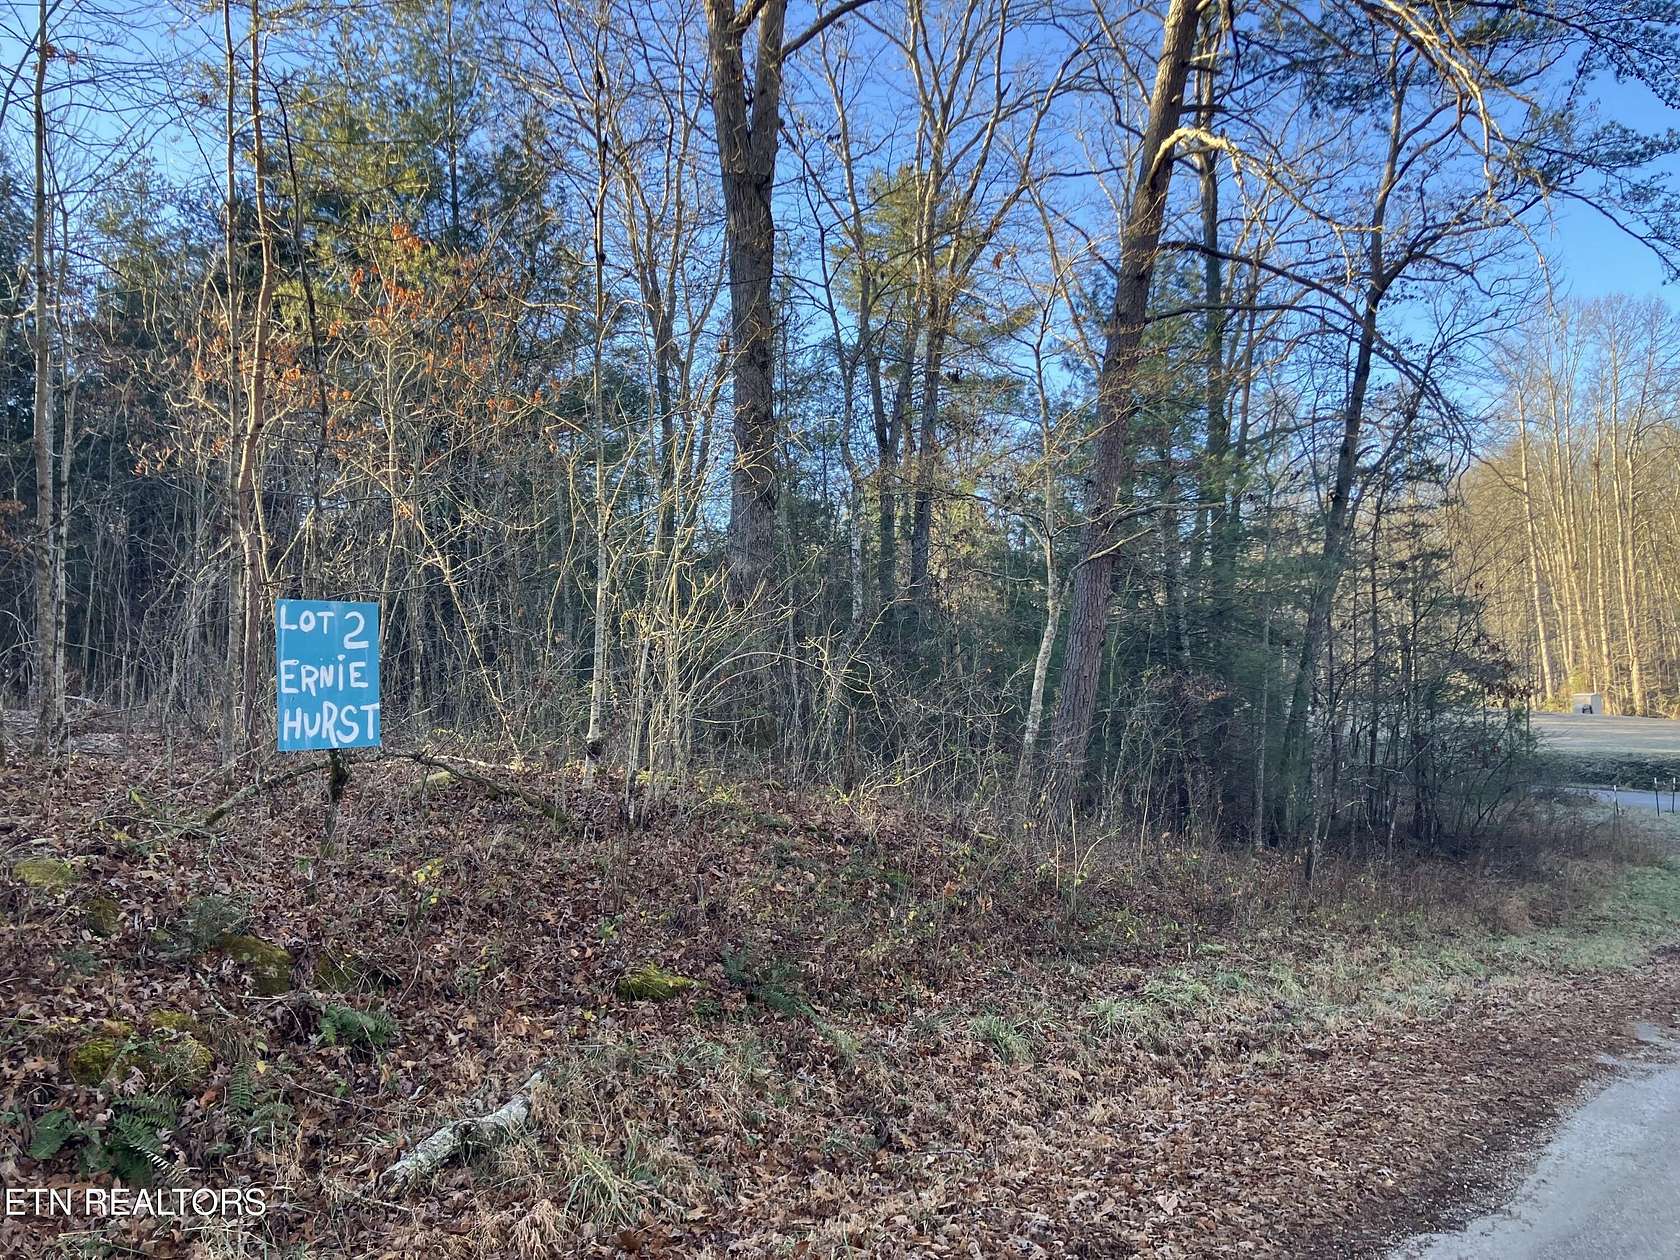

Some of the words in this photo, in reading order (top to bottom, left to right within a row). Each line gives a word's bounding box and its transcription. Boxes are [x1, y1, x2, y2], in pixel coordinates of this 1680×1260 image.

[280, 604, 335, 635] LOT
[343, 611, 369, 650] 2
[283, 700, 380, 748] HURST
